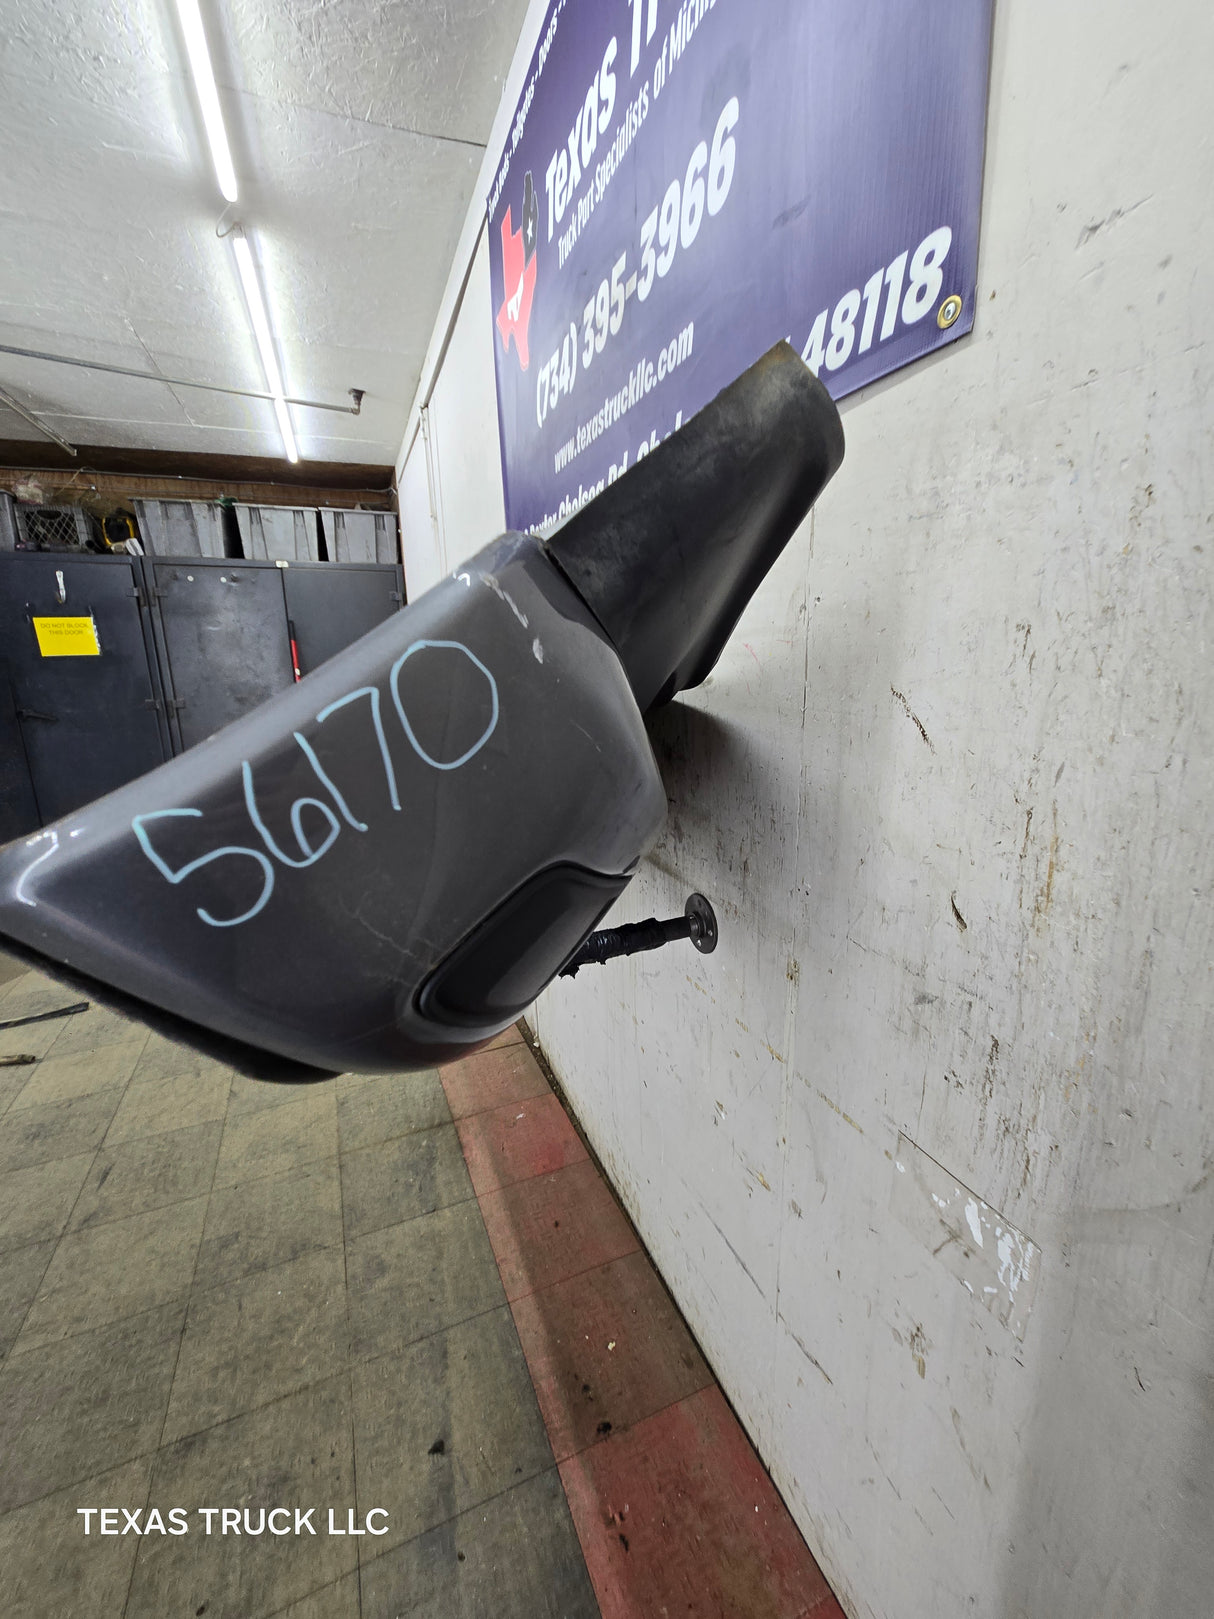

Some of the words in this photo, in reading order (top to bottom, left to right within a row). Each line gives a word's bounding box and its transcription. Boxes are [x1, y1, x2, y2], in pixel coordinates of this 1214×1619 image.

[538, 8, 558, 77] Doors
[545, 36, 618, 243] Texas
[558, 213, 577, 270] Truck
[577, 178, 595, 236] Part
[595, 80, 650, 204] Specialists
[653, 34, 668, 100] of
[536, 322, 578, 429] (734)
[582, 96, 740, 369] 395-3966
[800, 225, 953, 379] 48118
[554, 321, 695, 475] www.texastruckllc.com
[131, 640, 500, 927] 56170
